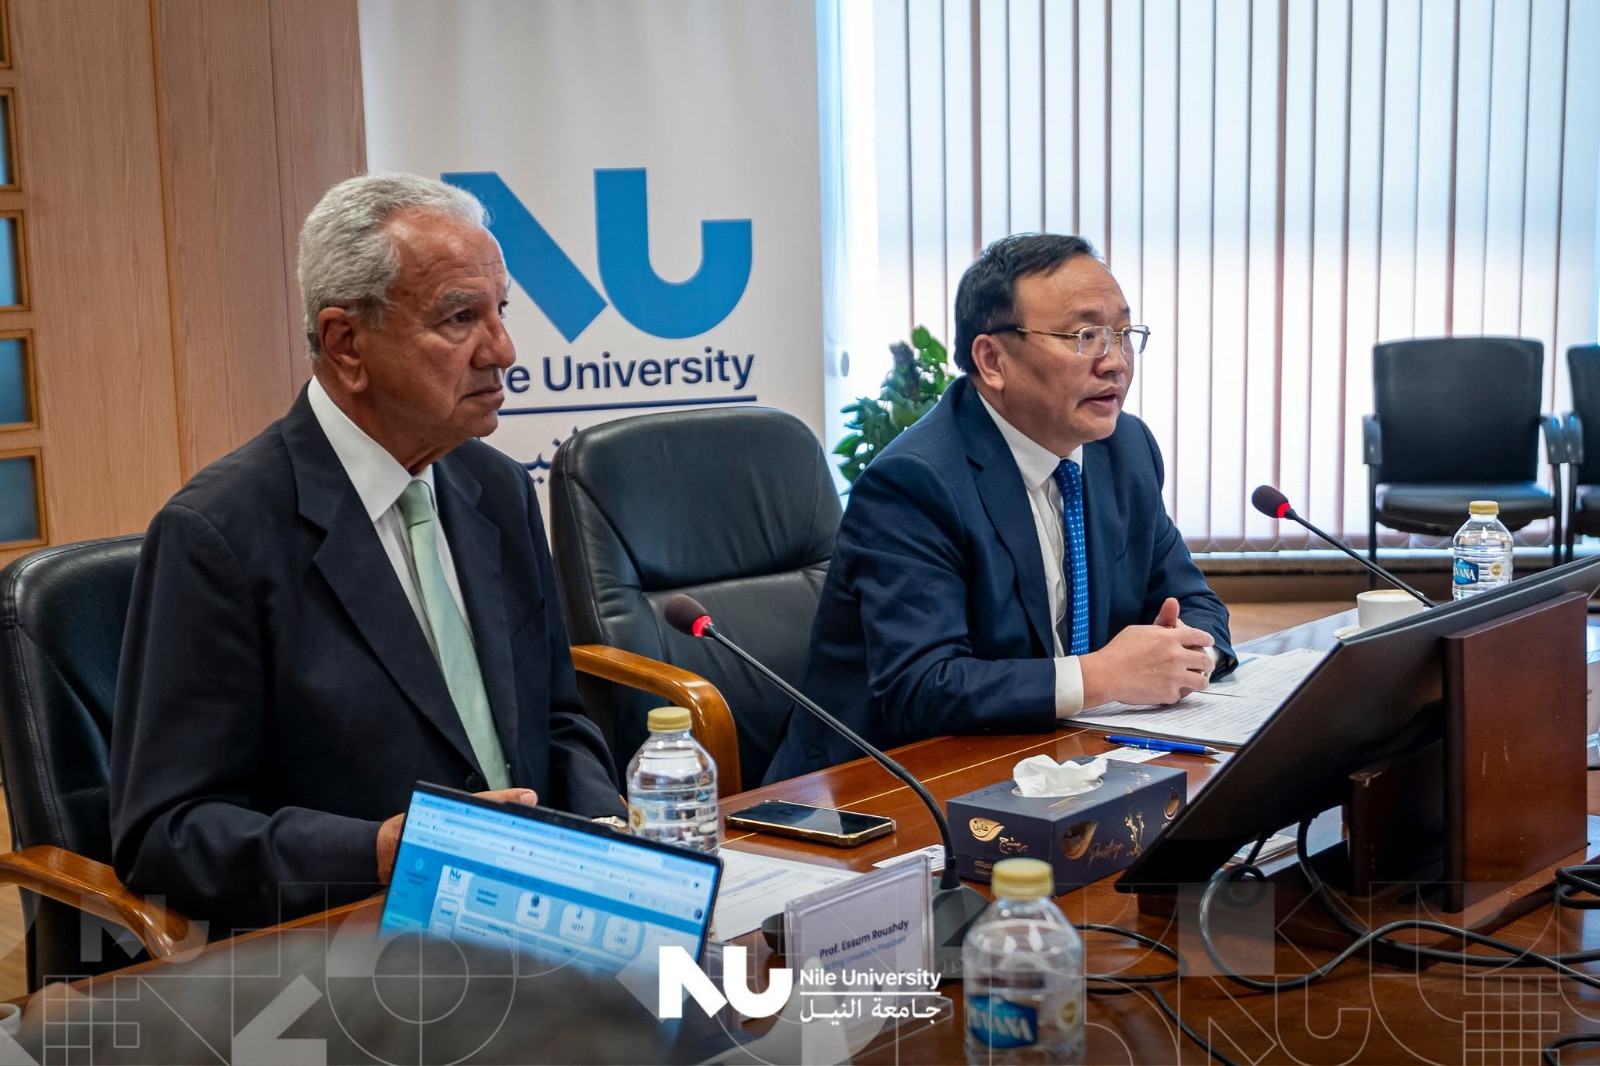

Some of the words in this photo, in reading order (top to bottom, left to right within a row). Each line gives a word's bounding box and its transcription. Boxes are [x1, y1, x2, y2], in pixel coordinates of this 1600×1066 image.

[543, 346, 755, 391] University
[819, 943, 840, 958] Prof.
[841, 934, 870, 950] Essam
[871, 920, 909, 940] Roushdy
